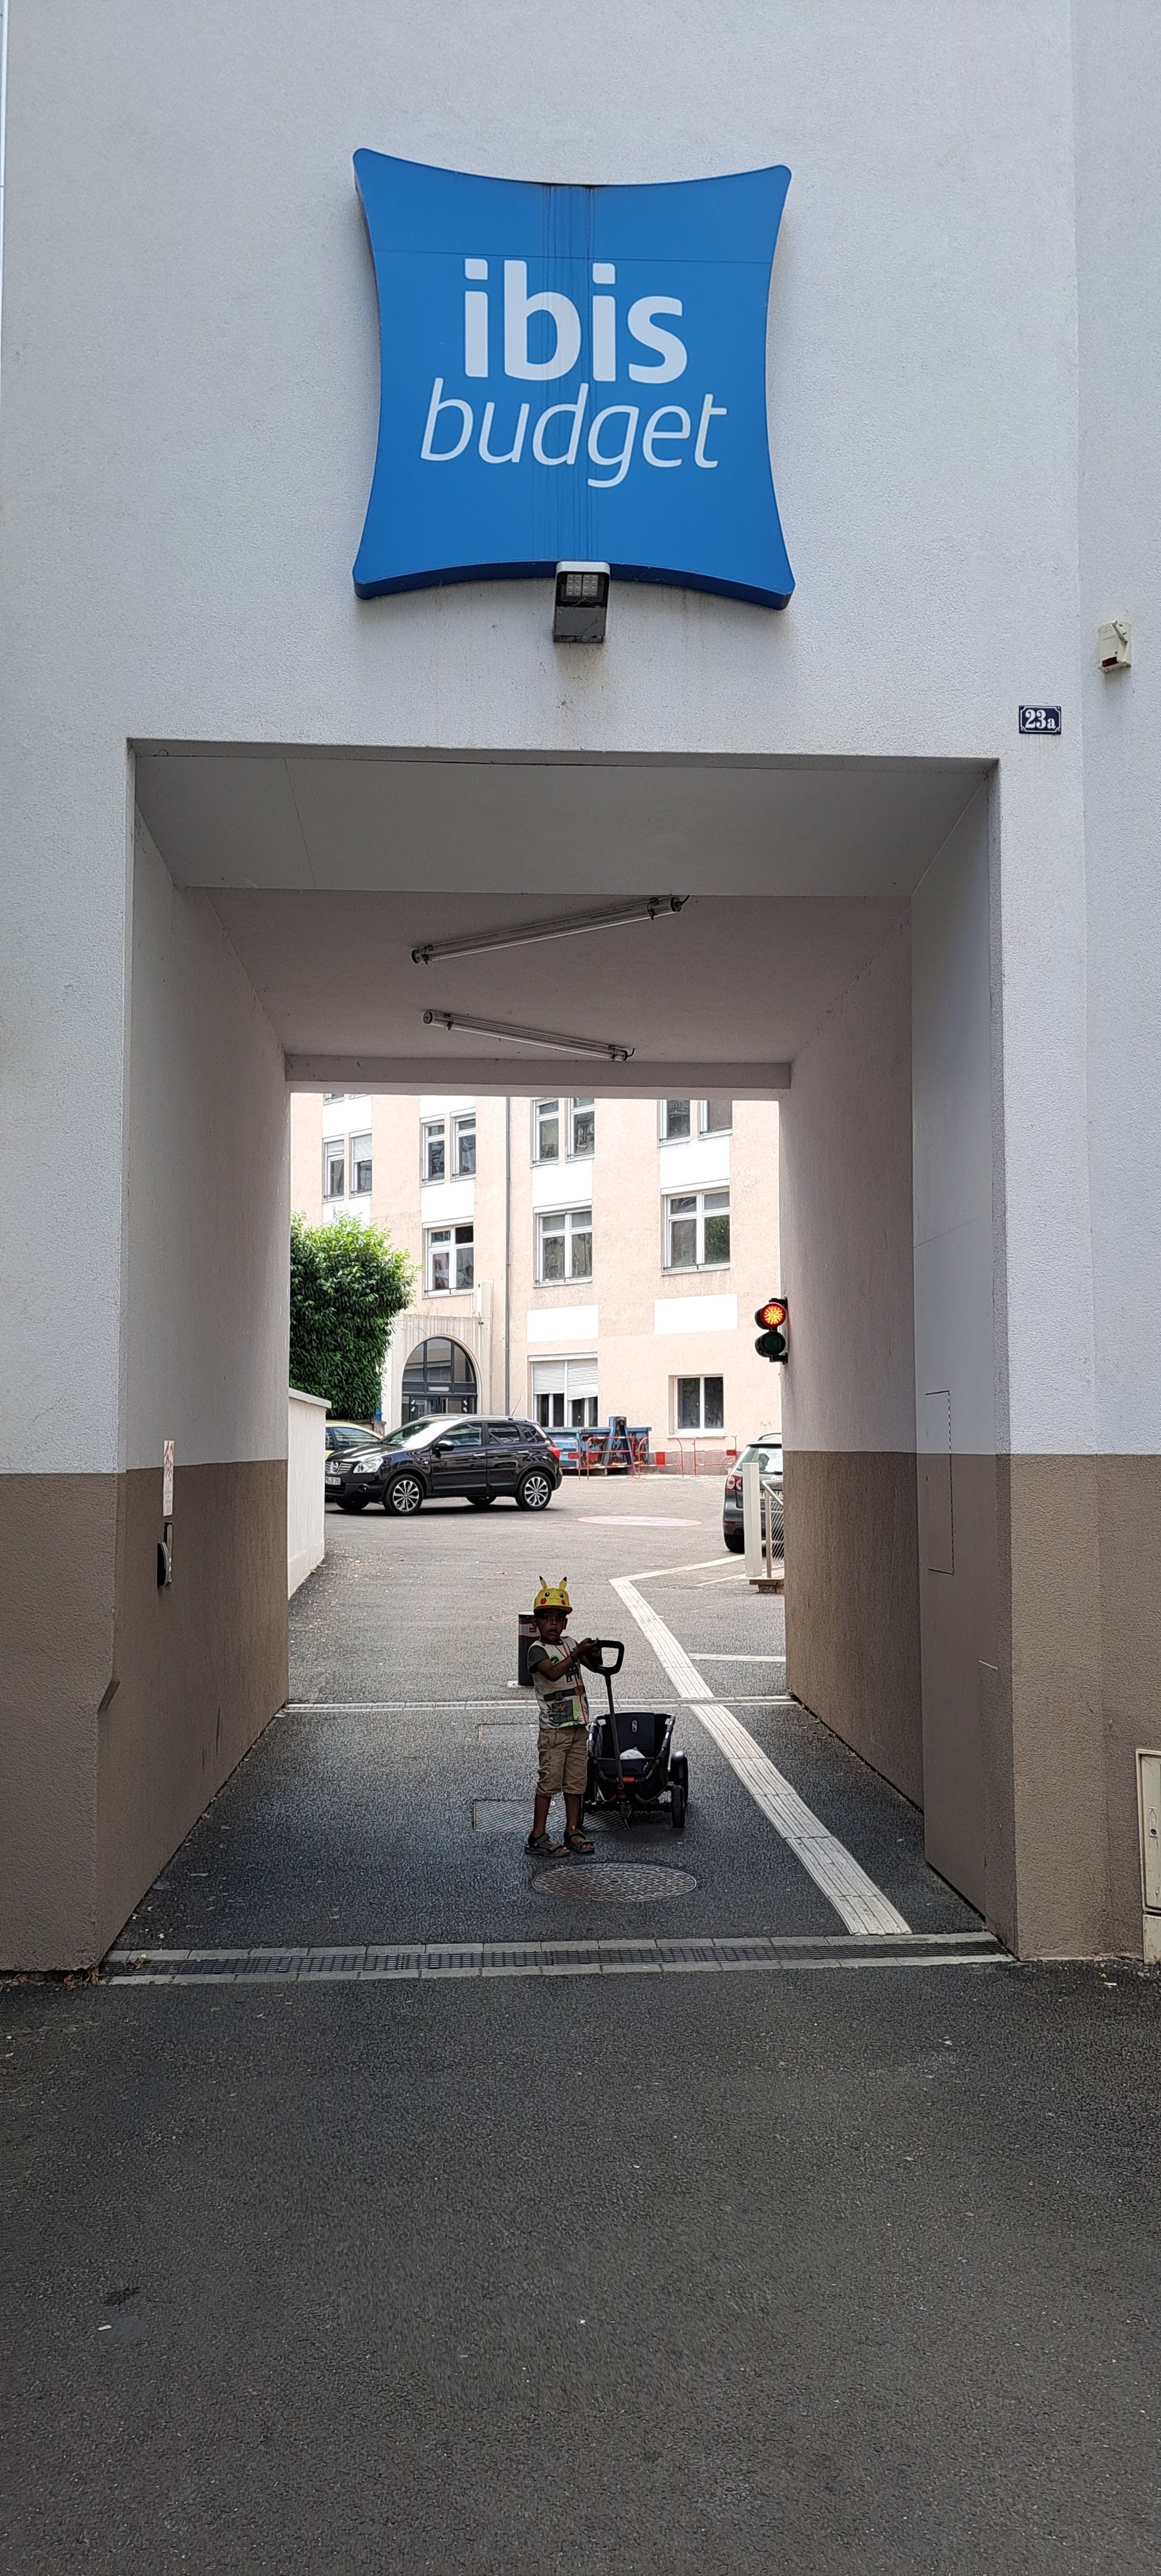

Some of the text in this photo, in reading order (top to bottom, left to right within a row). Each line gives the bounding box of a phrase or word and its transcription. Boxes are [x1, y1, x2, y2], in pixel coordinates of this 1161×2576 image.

[465, 258, 687, 384] ibis
[421, 377, 727, 488] budget
[1025, 709, 1056, 729] 23a
